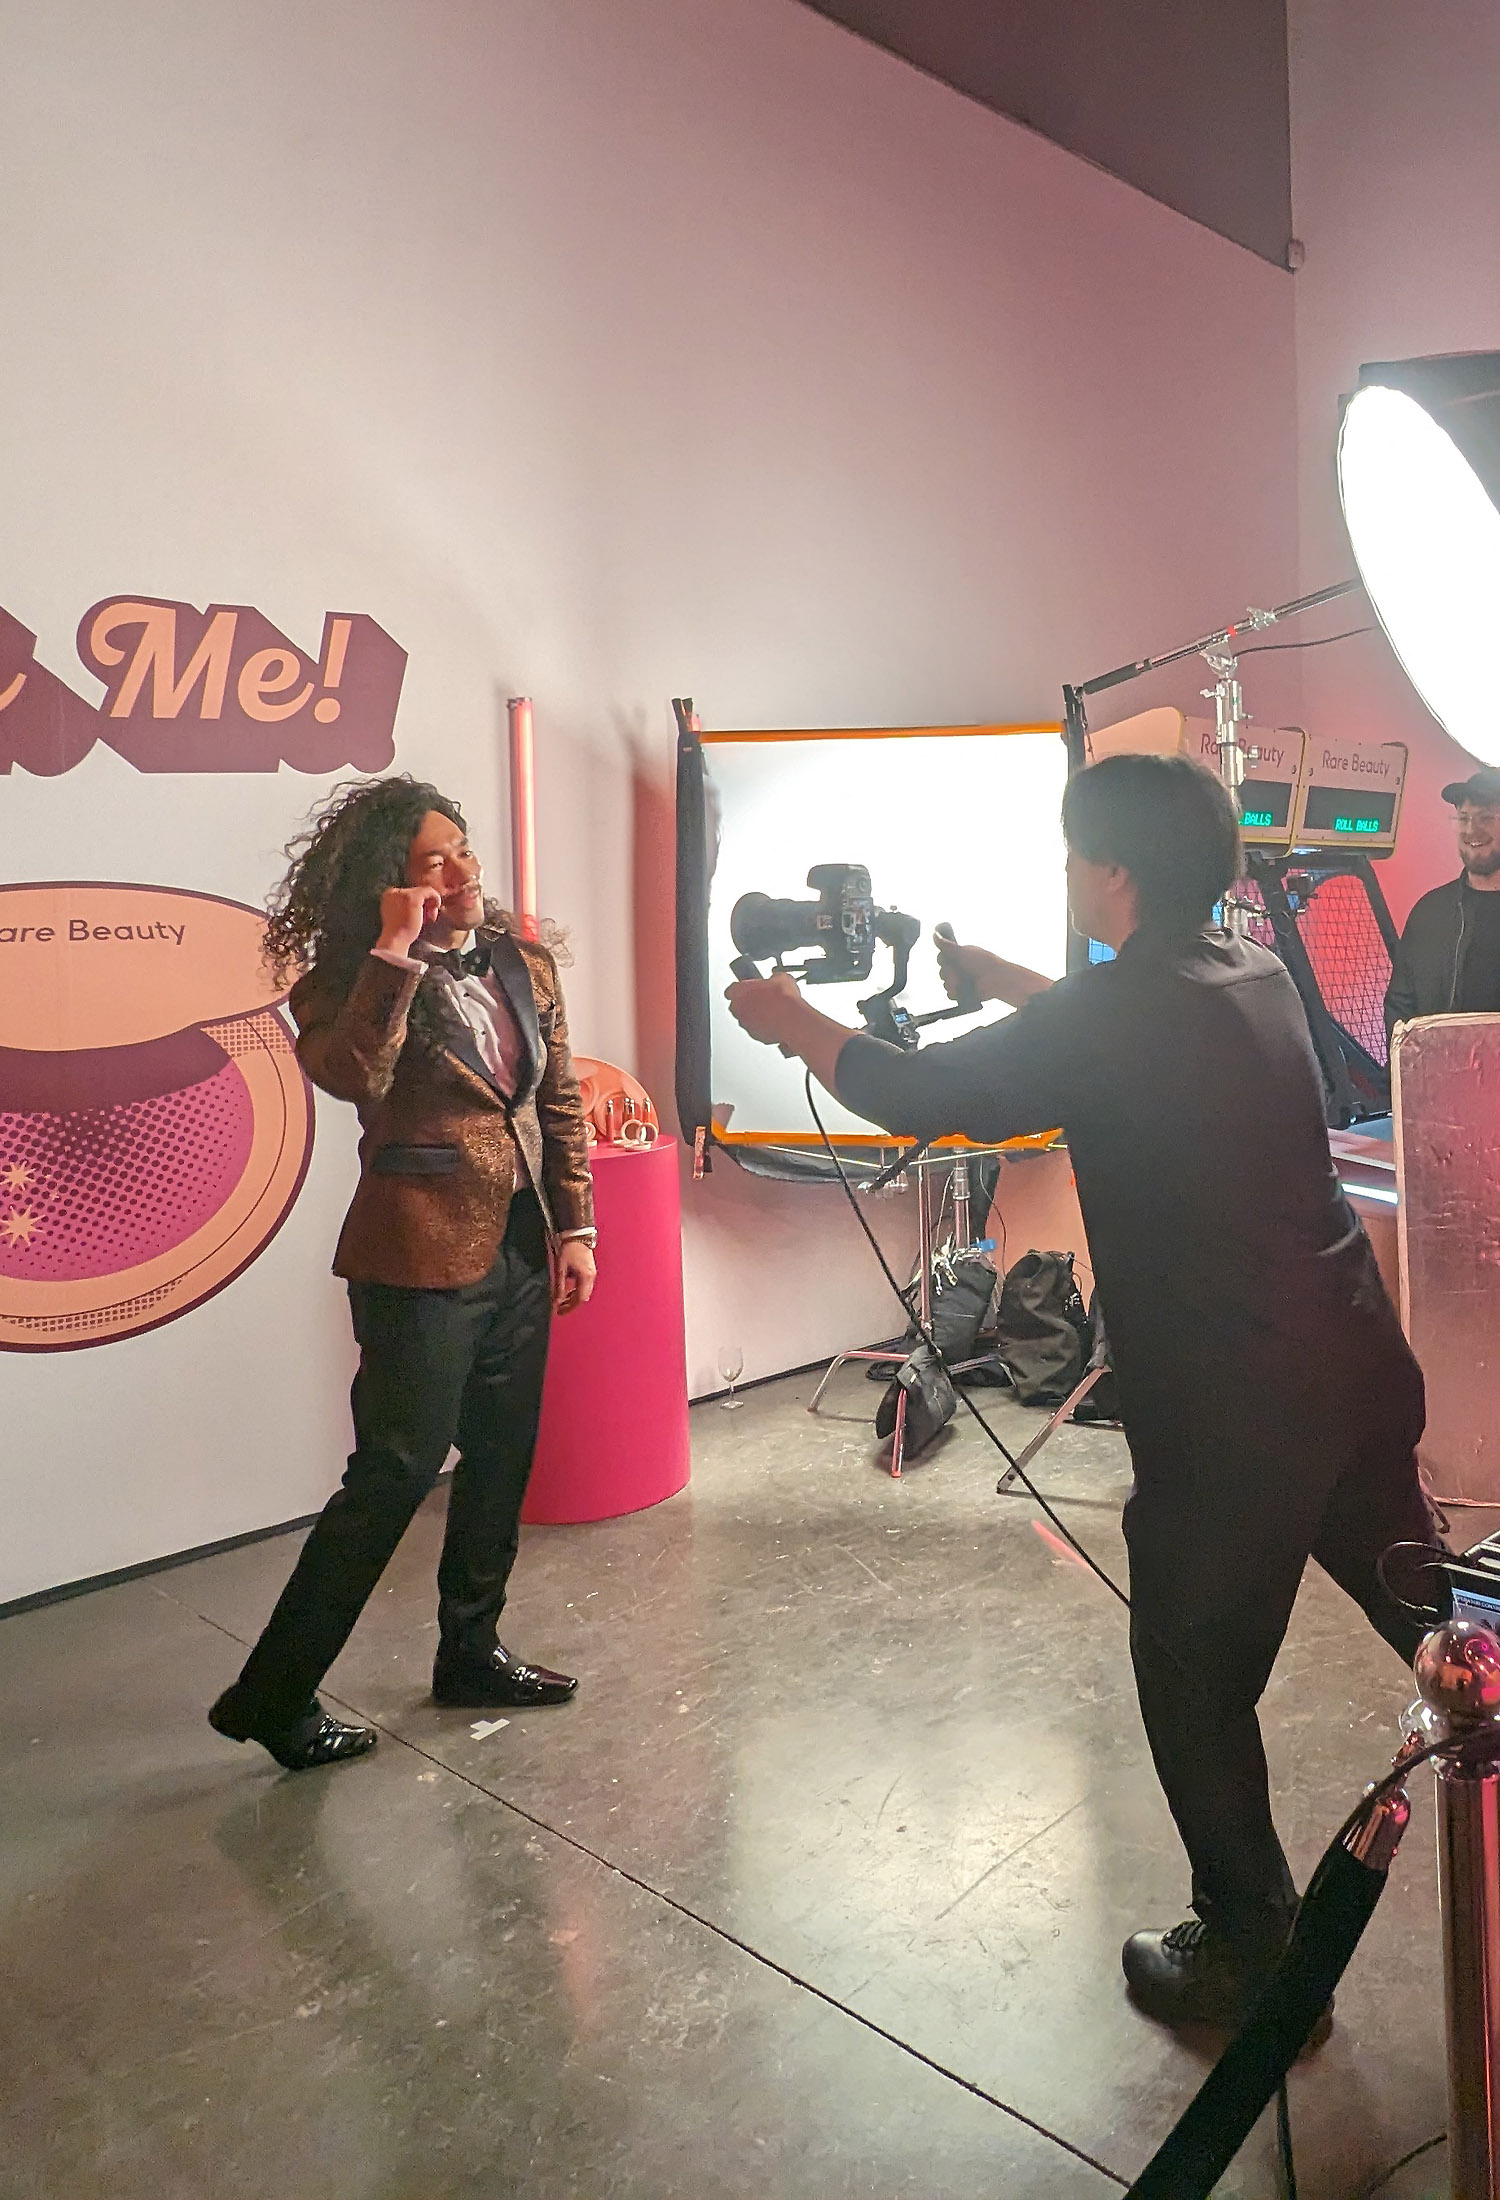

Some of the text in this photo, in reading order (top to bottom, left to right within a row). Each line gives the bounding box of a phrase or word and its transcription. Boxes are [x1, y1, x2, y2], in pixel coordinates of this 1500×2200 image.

[91, 602, 352, 724] Me!
[1322, 750, 1390, 778] Rare Beauty
[1244, 812, 1272, 826] BALLS
[1335, 818, 1379, 832] ROLL BALLS
[0, 919, 186, 946] are Beauty
